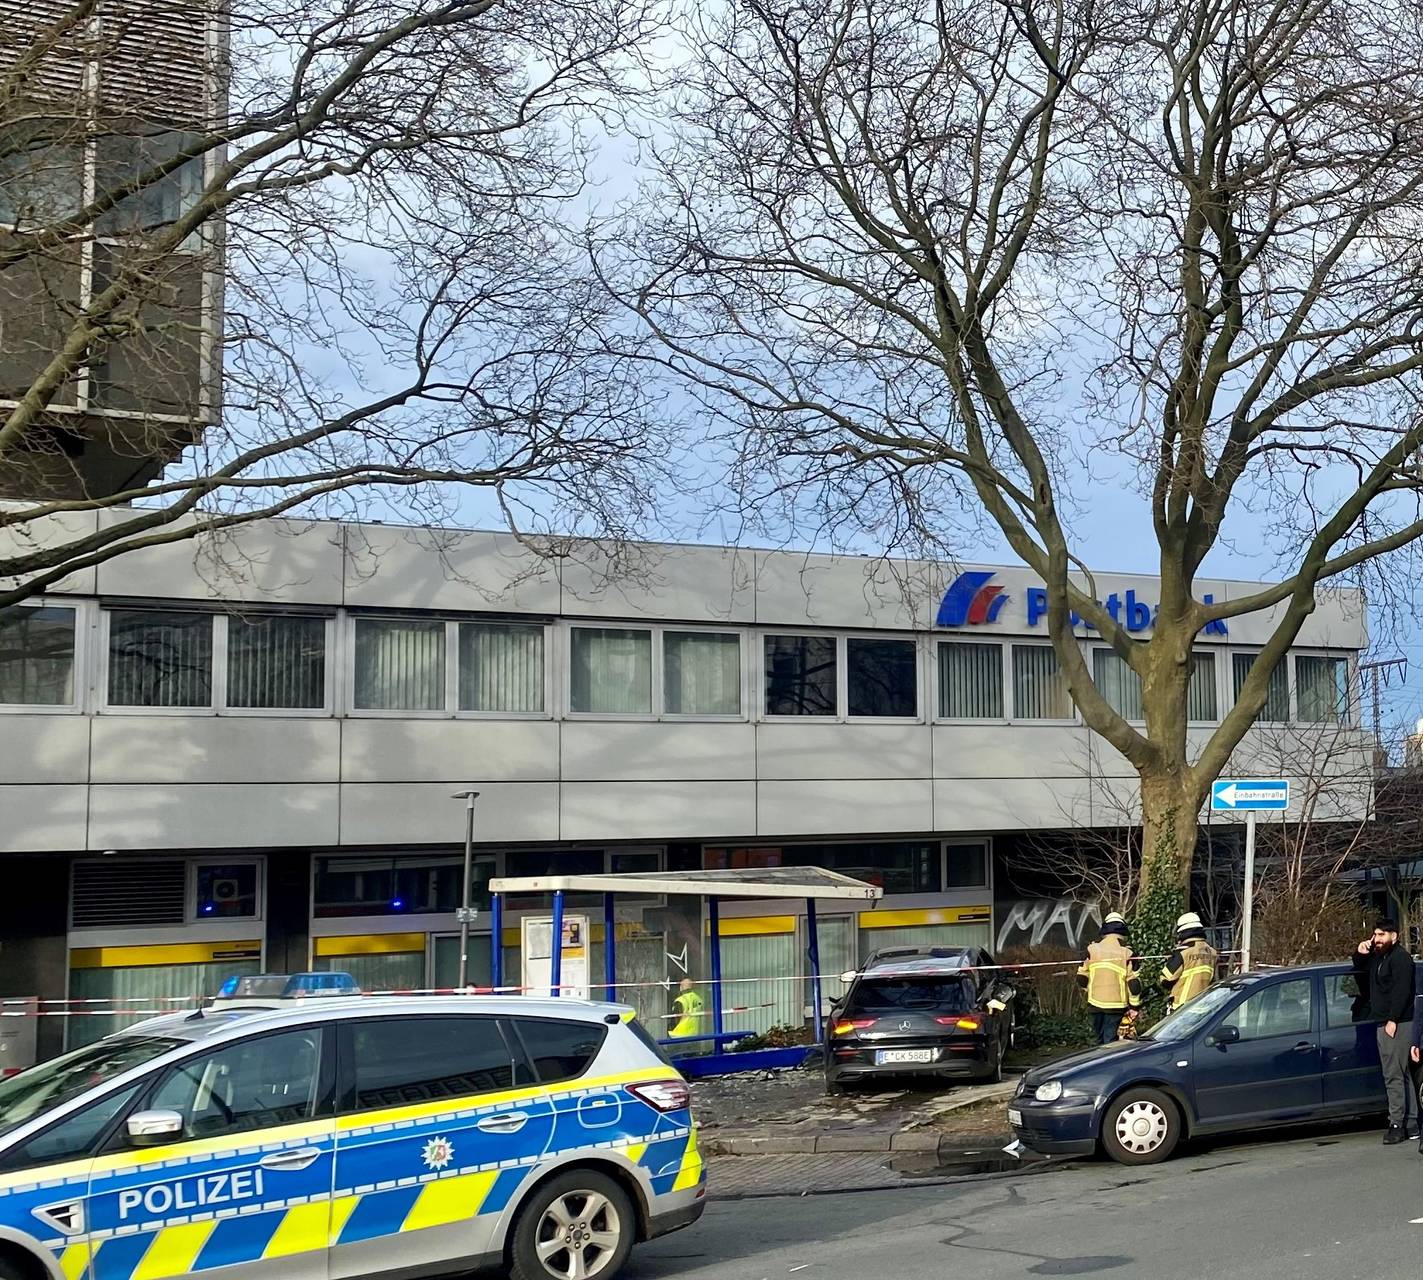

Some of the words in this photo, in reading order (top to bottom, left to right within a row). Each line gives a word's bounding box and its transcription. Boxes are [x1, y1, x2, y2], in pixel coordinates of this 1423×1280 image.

[1027, 587, 1228, 637] Ptbk
[864, 889, 875, 899] 13
[119, 1168, 264, 1220] POLIZEI
